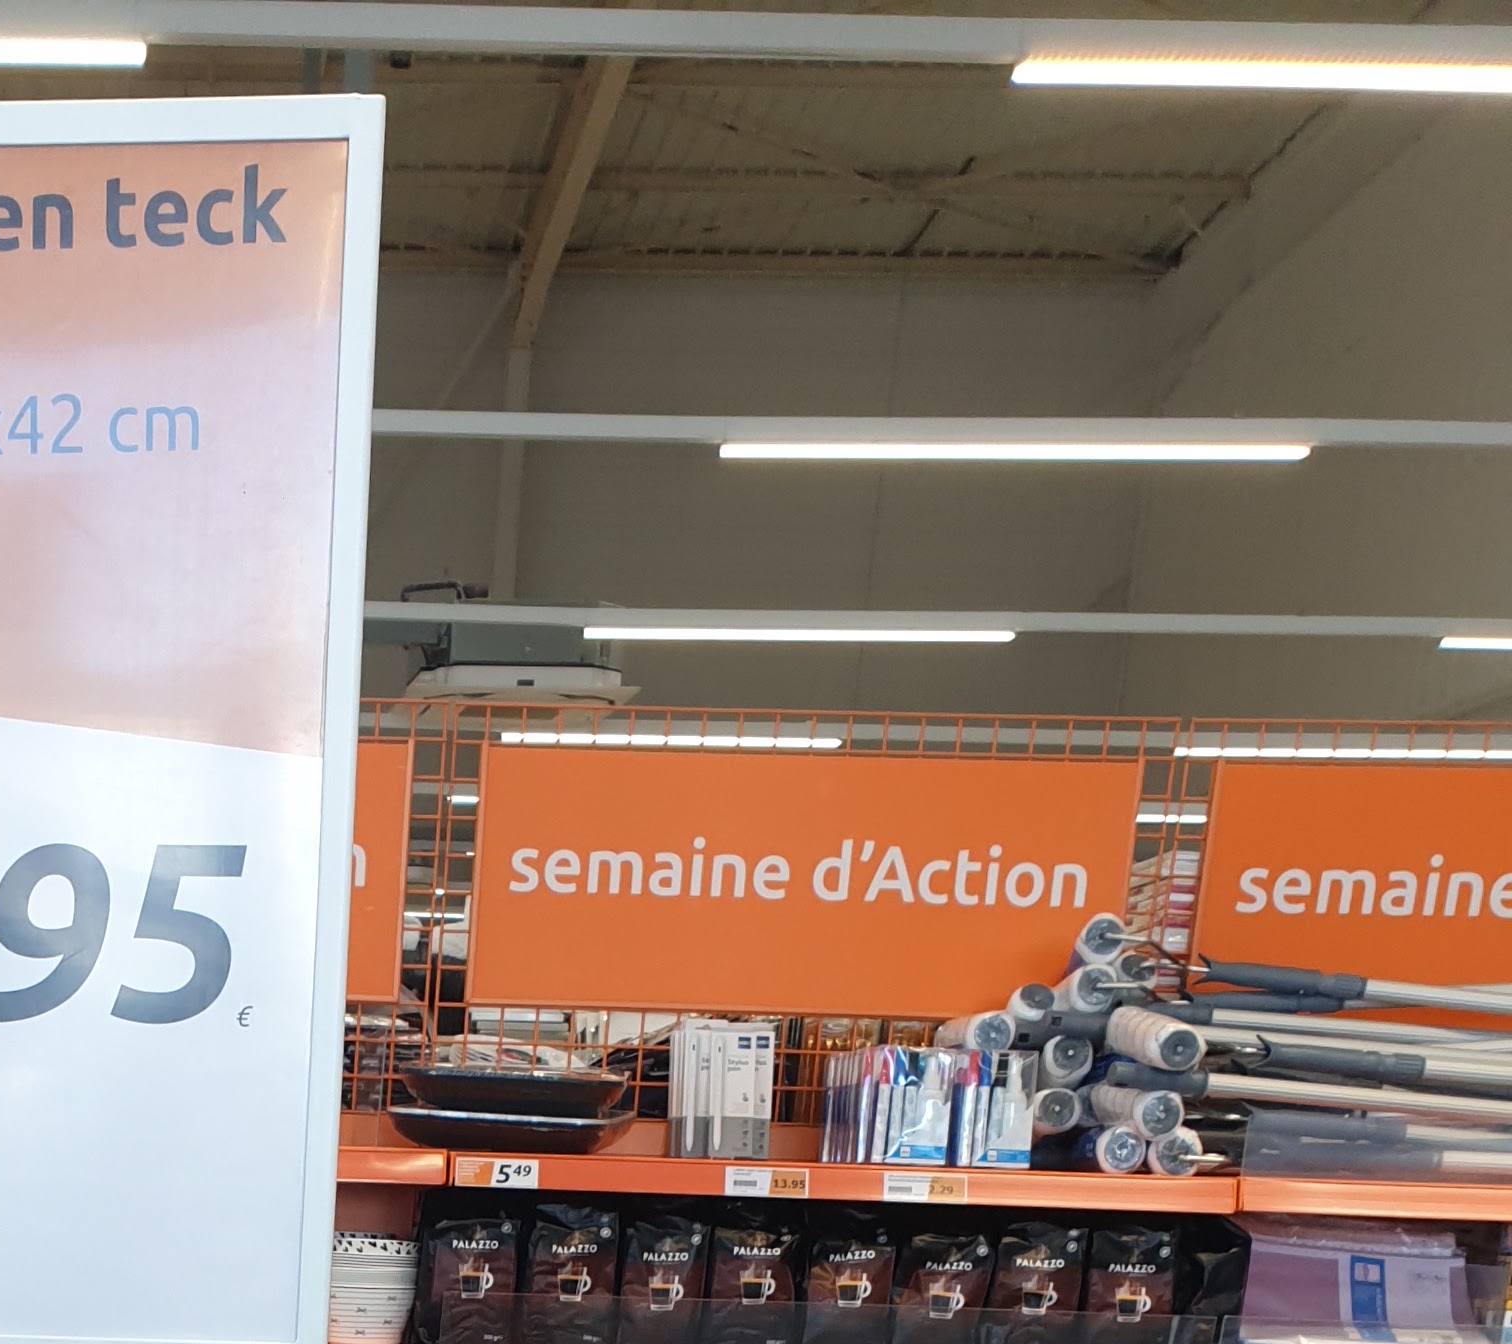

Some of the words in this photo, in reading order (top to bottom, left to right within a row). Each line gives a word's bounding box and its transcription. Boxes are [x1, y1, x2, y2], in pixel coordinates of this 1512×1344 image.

[104, 164, 289, 248] teck
[108, 402, 201, 453] cm
[509, 836, 790, 900] semaine
[812, 838, 1088, 909] d'Action
[1235, 854, 1512, 918] semaine
[773, 1179, 806, 1190] 13.95
[929, 1185, 954, 1195] 2.29
[452, 1239, 499, 1251] PALAZZO
[551, 1243, 598, 1254] PALAZZO
[643, 1251, 689, 1263] PALAZZO
[733, 1246, 781, 1257] PALAZZO
[829, 1249, 876, 1262] PALAZZO
[925, 1261, 973, 1272] PALAZZO
[1016, 1258, 1065, 1269] PALAZZO
[1108, 1263, 1157, 1274] PALAZZO
